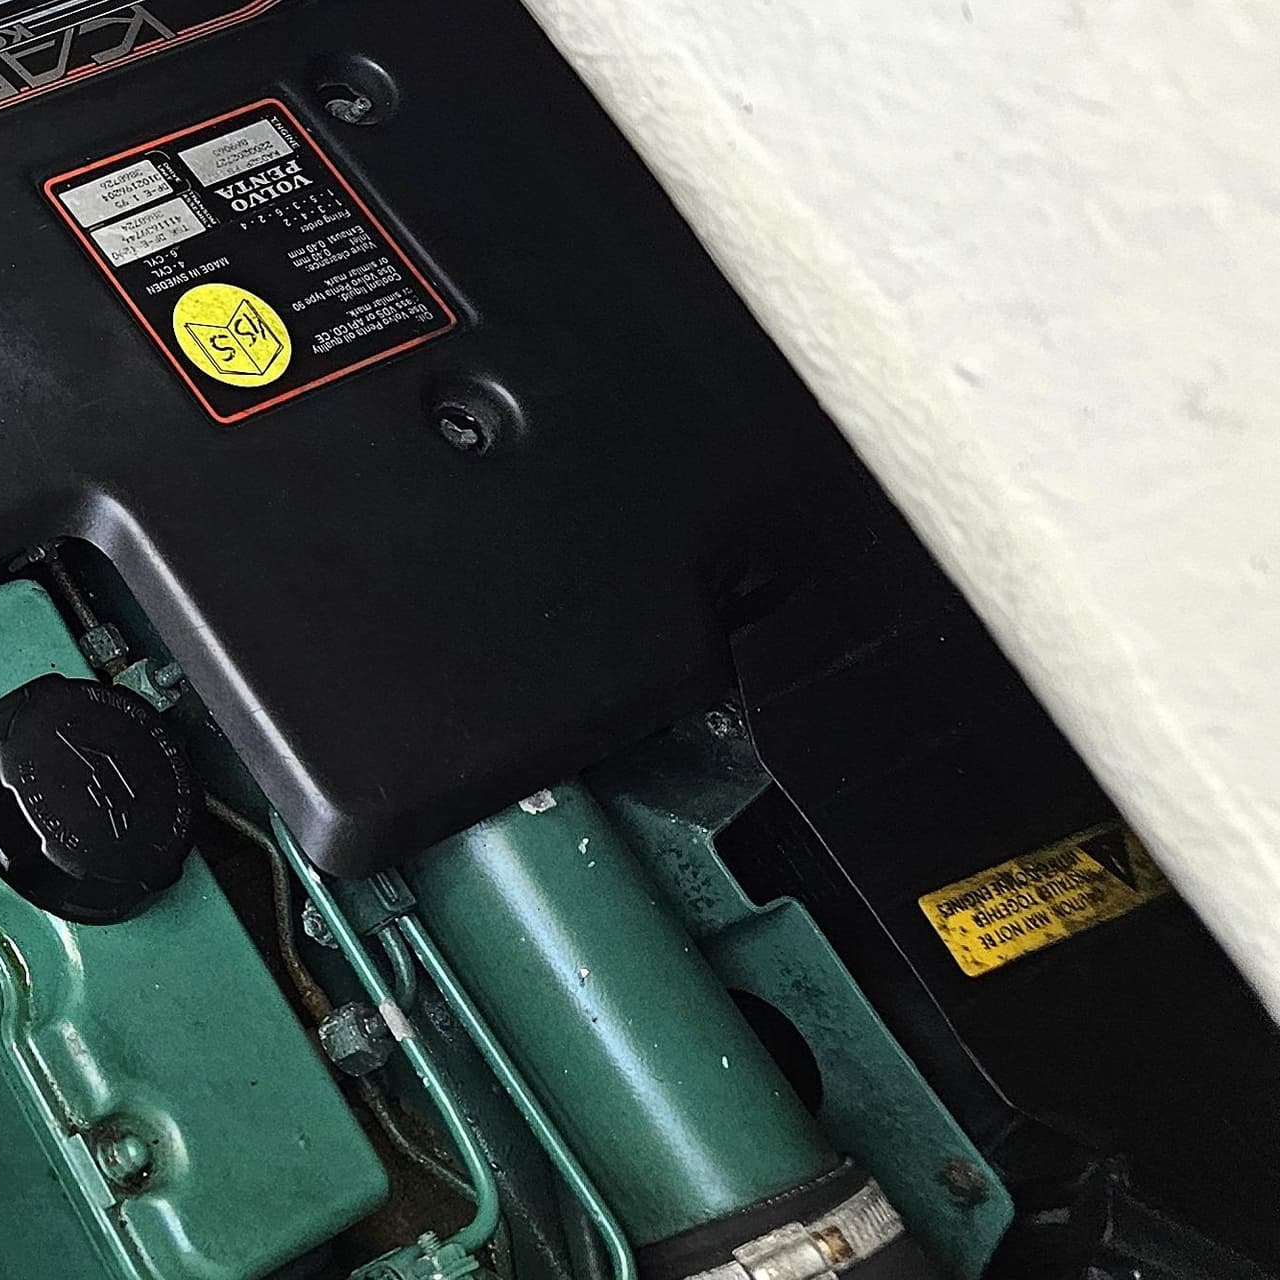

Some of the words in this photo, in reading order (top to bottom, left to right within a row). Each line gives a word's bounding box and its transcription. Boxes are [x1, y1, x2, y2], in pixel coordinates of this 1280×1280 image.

[213, 159, 302, 198] PENTA
[229, 173, 313, 212] VOLVO
[321, 205, 351, 226] Firing
[299, 218, 324, 235] order
[325, 222, 363, 246] Exhaust
[304, 238, 325, 254] 0.40
[348, 230, 370, 247] Inlet
[349, 238, 376, 257] Valve
[142, 253, 164, 269] CYL
[286, 245, 305, 260] mm
[292, 254, 311, 268] mm
[303, 246, 351, 275] clearance:
[310, 246, 331, 262] 0.40
[377, 255, 388, 265] or
[150, 264, 173, 279] CYL
[188, 266, 201, 278] IN
[199, 254, 229, 274] MADE
[347, 258, 378, 279] similar
[376, 262, 395, 278] Use
[145, 271, 189, 295] SWEDEN
[323, 271, 347, 288] mark
[350, 269, 377, 289] Volvo
[366, 269, 401, 292] Coolant
[303, 289, 326, 307] type
[324, 279, 351, 299] Penta
[336, 283, 366, 303] liquid:
[291, 299, 305, 312] 90
[371, 289, 402, 309] similar
[344, 301, 372, 320] mark.
[364, 311, 376, 322] or
[375, 303, 395, 319] VDS
[381, 308, 409, 328] Volvo
[407, 301, 427, 317] Use
[414, 309, 433, 325] Oil:
[346, 316, 364, 331] API
[354, 318, 383, 338] Penta
[310, 333, 344, 356] quality
[313, 329, 330, 344] CE
[342, 330, 356, 343] oil
[935, 884, 992, 918] ENGINES
[971, 892, 1037, 929] TOGETHER
[1020, 909, 1050, 932] MAY
[977, 932, 995, 951] BE
[993, 920, 1023, 945] NOT
